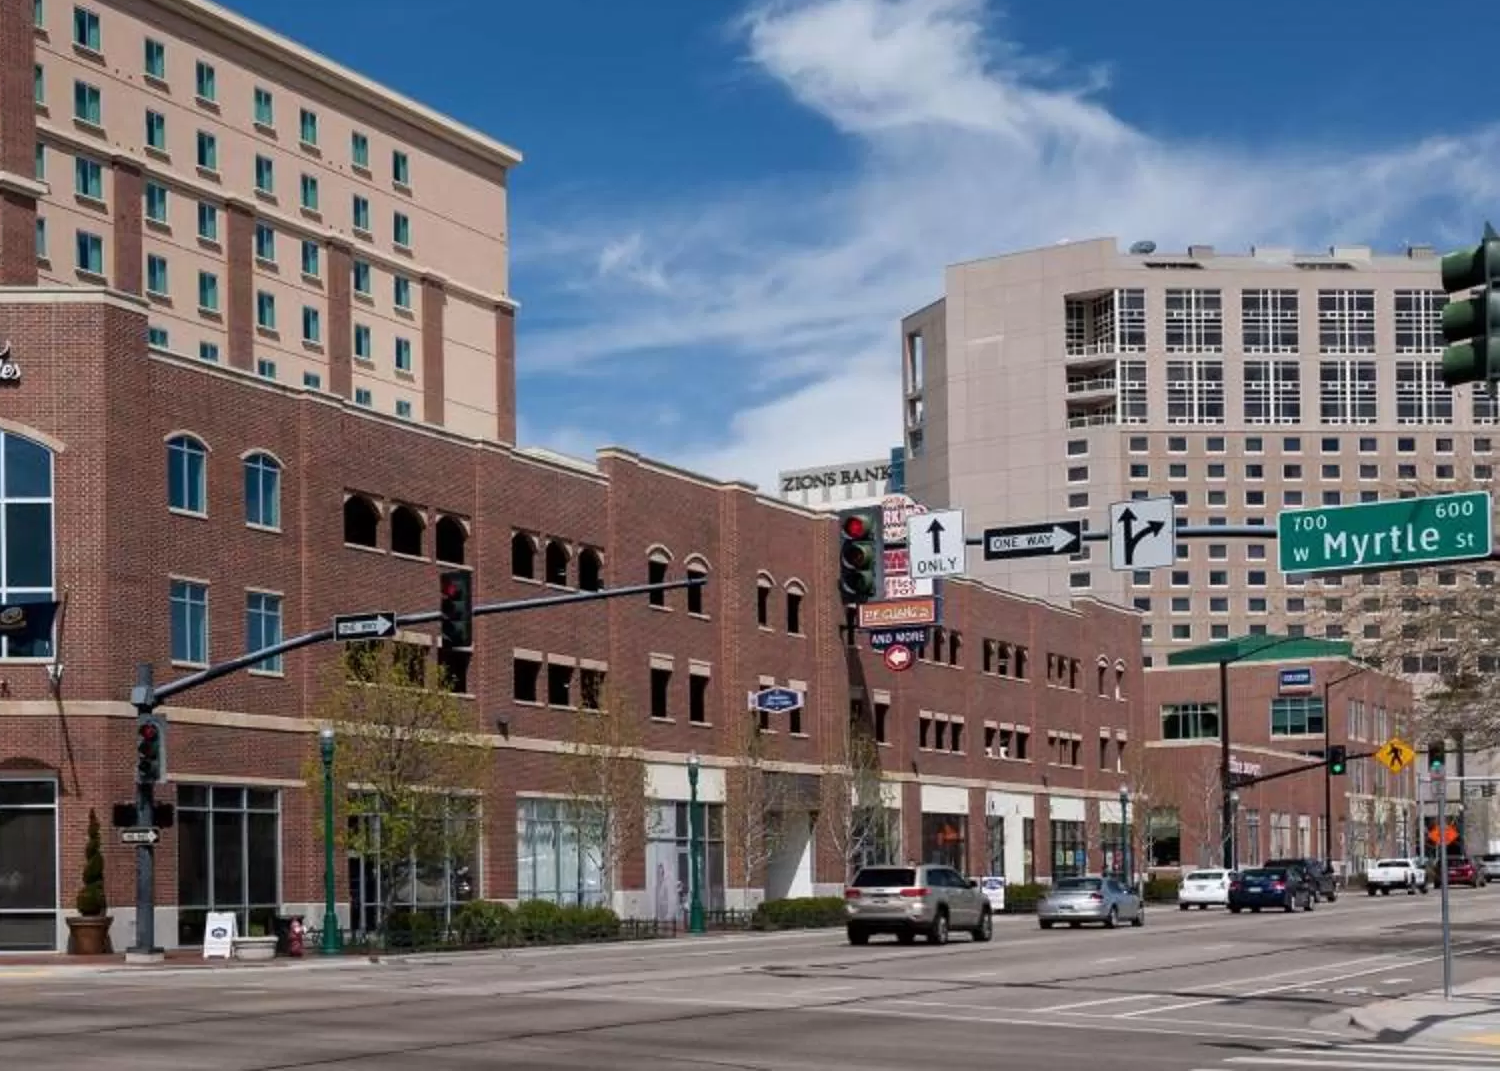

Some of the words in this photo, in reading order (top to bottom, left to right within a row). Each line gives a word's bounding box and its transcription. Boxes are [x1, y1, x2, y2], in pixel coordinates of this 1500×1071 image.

[781, 472, 837, 491] ZIONS
[840, 464, 892, 485] BANK
[1293, 515, 1328, 531] 700
[1435, 501, 1474, 518] 600
[993, 536, 1018, 549] ONE
[1026, 533, 1054, 546] WAY
[1293, 547, 1310, 562] W
[1323, 523, 1441, 564] Myrtle
[1455, 533, 1475, 548] St
[917, 557, 957, 574] ONLY
[871, 633, 893, 644] AND
[895, 630, 925, 642] MORE
